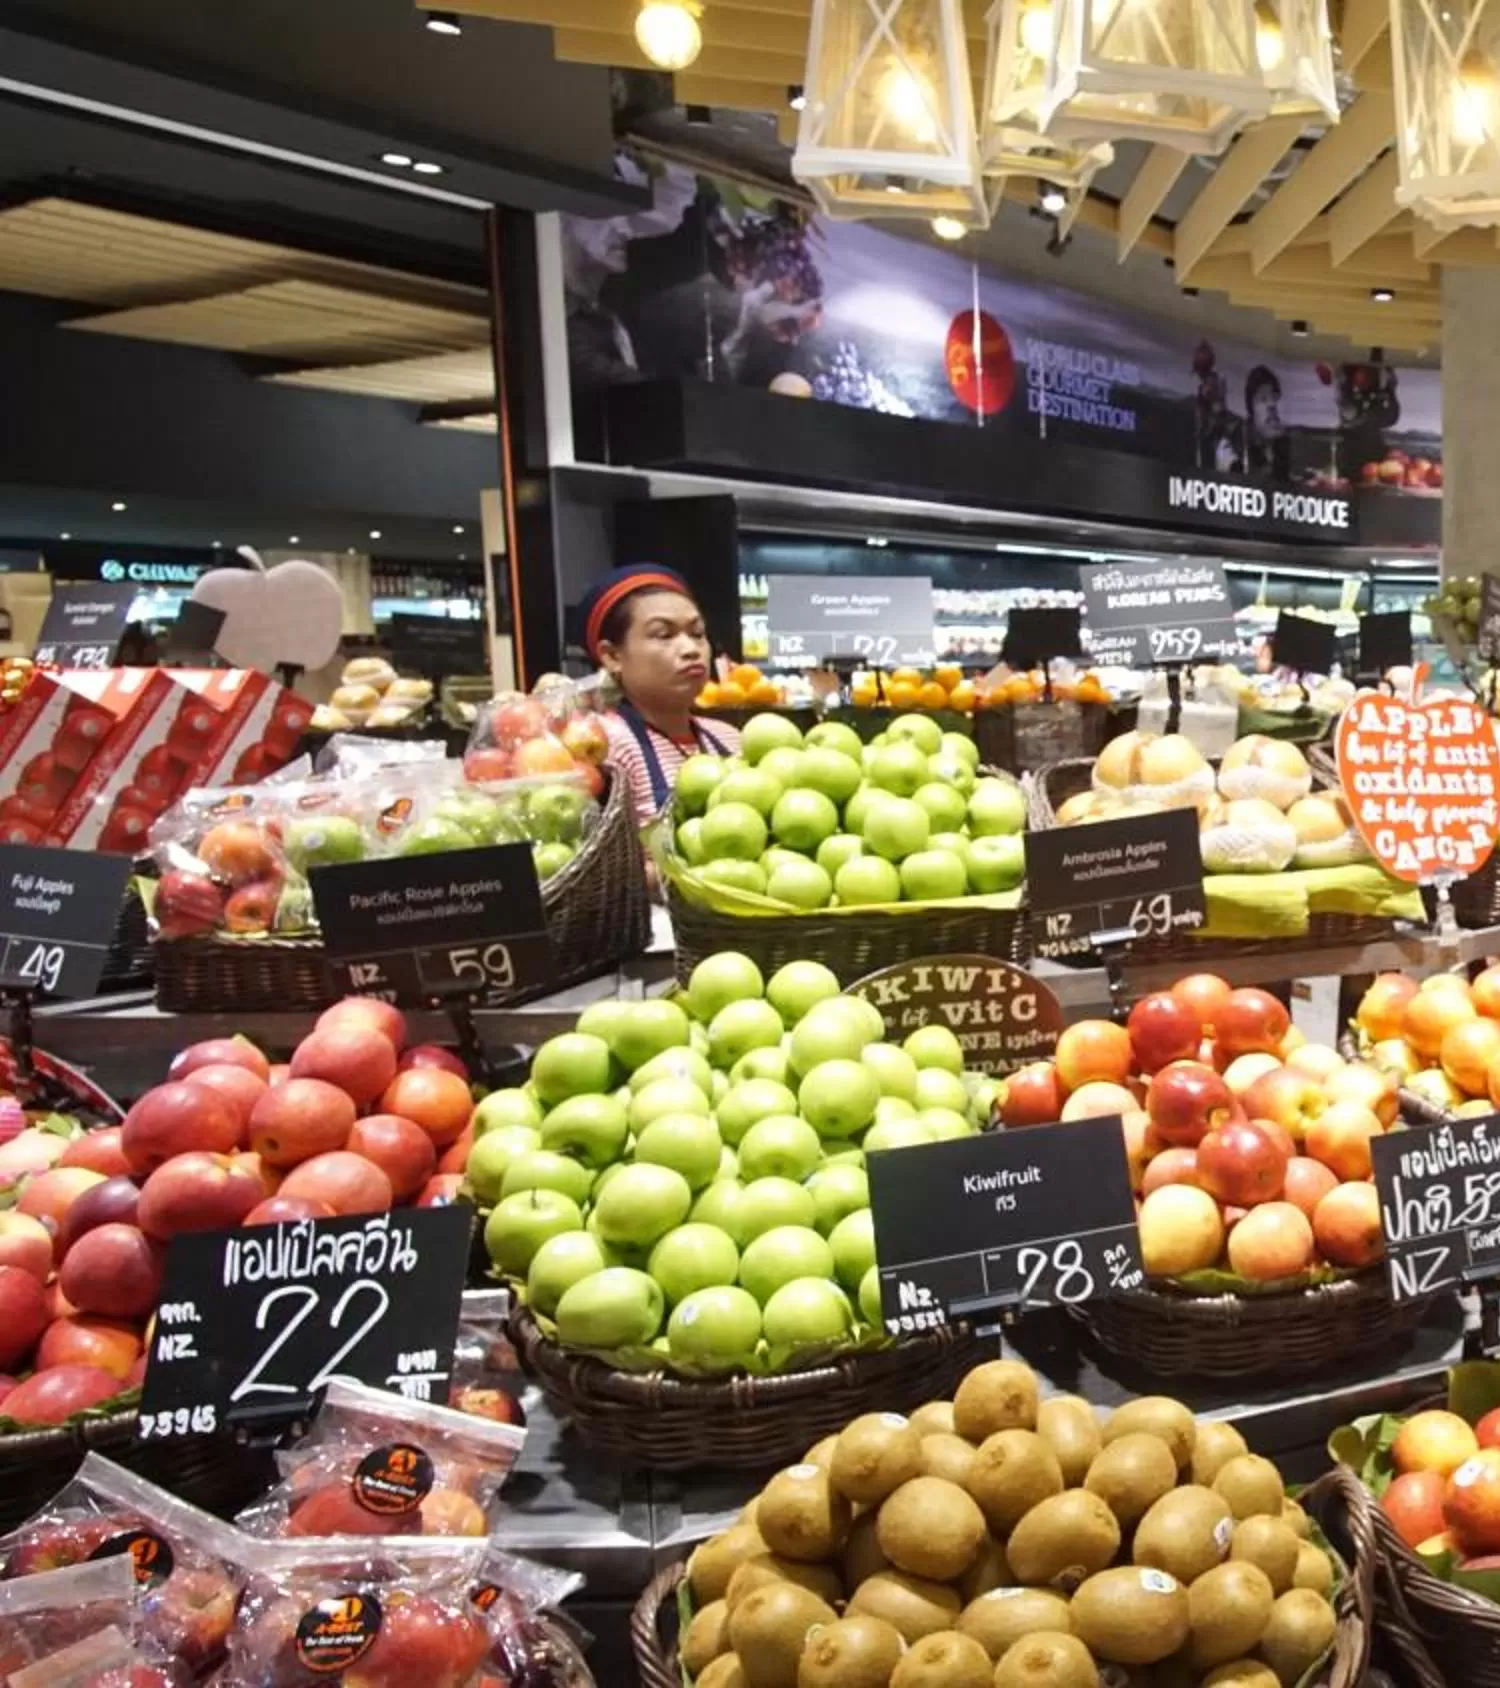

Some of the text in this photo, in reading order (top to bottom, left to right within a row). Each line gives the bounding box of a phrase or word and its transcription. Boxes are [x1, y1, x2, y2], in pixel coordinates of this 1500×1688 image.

[1026, 339, 1140, 385] WORLD CLASS
[1027, 366, 1110, 403] GOURMET
[1028, 389, 1136, 431] DESTINATION
[1169, 476, 1350, 529] IMPORTED PRODUCE
[1107, 589, 1171, 609] KOREAN
[1354, 767, 1495, 796] oxidants
[1062, 841, 1167, 867] Ambrosia Apples
[1375, 824, 1493, 870] CANCER
[11, 873, 75, 895] Fuji Apples
[350, 879, 503, 911] Pacific Rose Apples
[1046, 914, 1072, 937] NZ
[1129, 894, 1172, 936] 69
[18, 943, 65, 991] 49
[449, 943, 514, 987] 59
[939, 1000, 1003, 1026] Vit
[1010, 993, 1038, 1021] C
[963, 1165, 1042, 1194] Kiwifruit
[1384, 1175, 1452, 1241] ปกติ
[1391, 1247, 1458, 1301] NZ
[230, 1279, 390, 1401] 22
[139, 1404, 217, 1439] 75965
